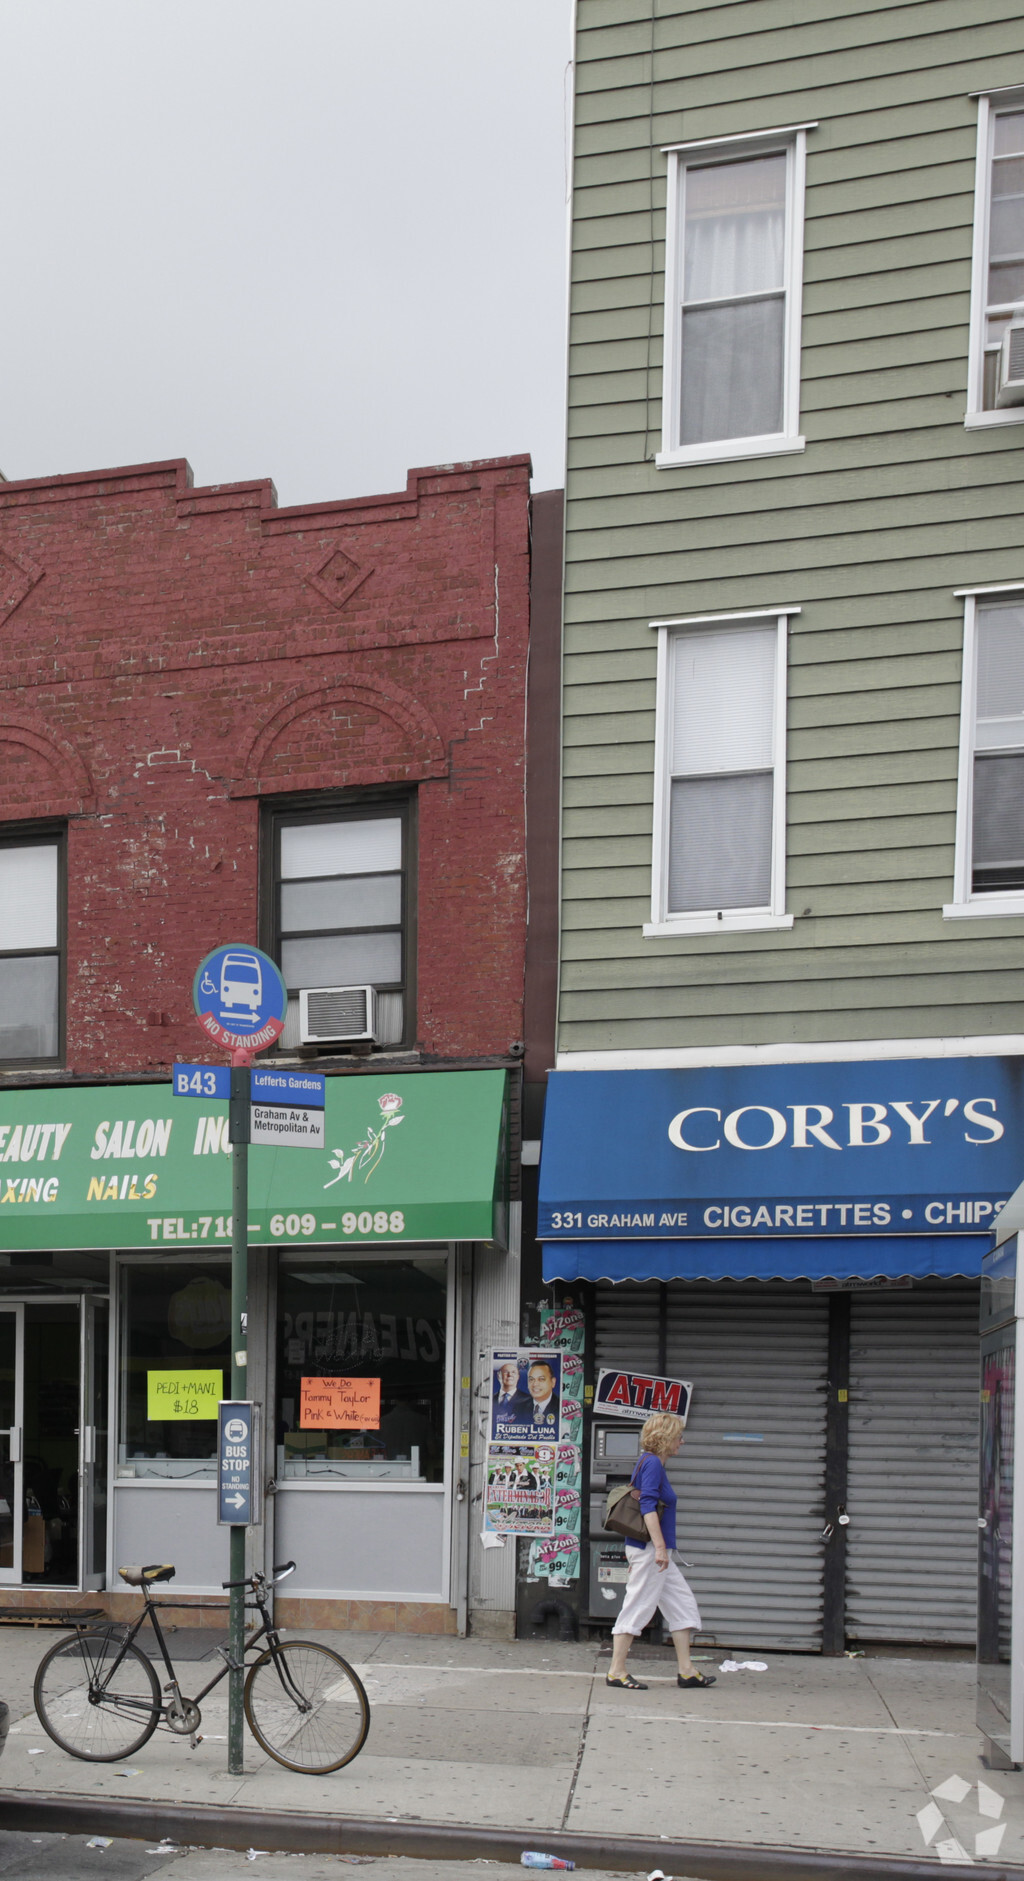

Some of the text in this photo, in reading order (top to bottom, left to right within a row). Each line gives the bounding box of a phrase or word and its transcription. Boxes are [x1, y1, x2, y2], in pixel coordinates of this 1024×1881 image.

[204, 1016, 276, 1048] NO STANDING
[178, 1071, 217, 1095] B43
[254, 1074, 322, 1091] Lefferts Gardens
[254, 1108, 309, 1122] Graham Av &
[668, 1098, 1005, 1151] CORBY'S
[254, 1120, 321, 1135] Metropolitan Av
[90, 1119, 172, 1160] SALON
[86, 1173, 159, 1201] NAILS
[341, 1211, 405, 1235] 9088
[551, 1212, 582, 1229] 331
[587, 1213, 656, 1228] GRAHAM
[659, 1212, 688, 1227] AVE
[703, 1203, 892, 1228] CIGARETTES
[322, 1379, 352, 1387] We Do
[605, 1374, 682, 1413] ATM
[173, 1399, 199, 1415] $18
[621, 1408, 654, 1418] atmwor
[496, 1423, 556, 1434] RUBEN LUNA
[225, 1446, 247, 1457] BUS
[222, 1459, 250, 1471] STOP
[536, 1536, 580, 1557] AriZona
